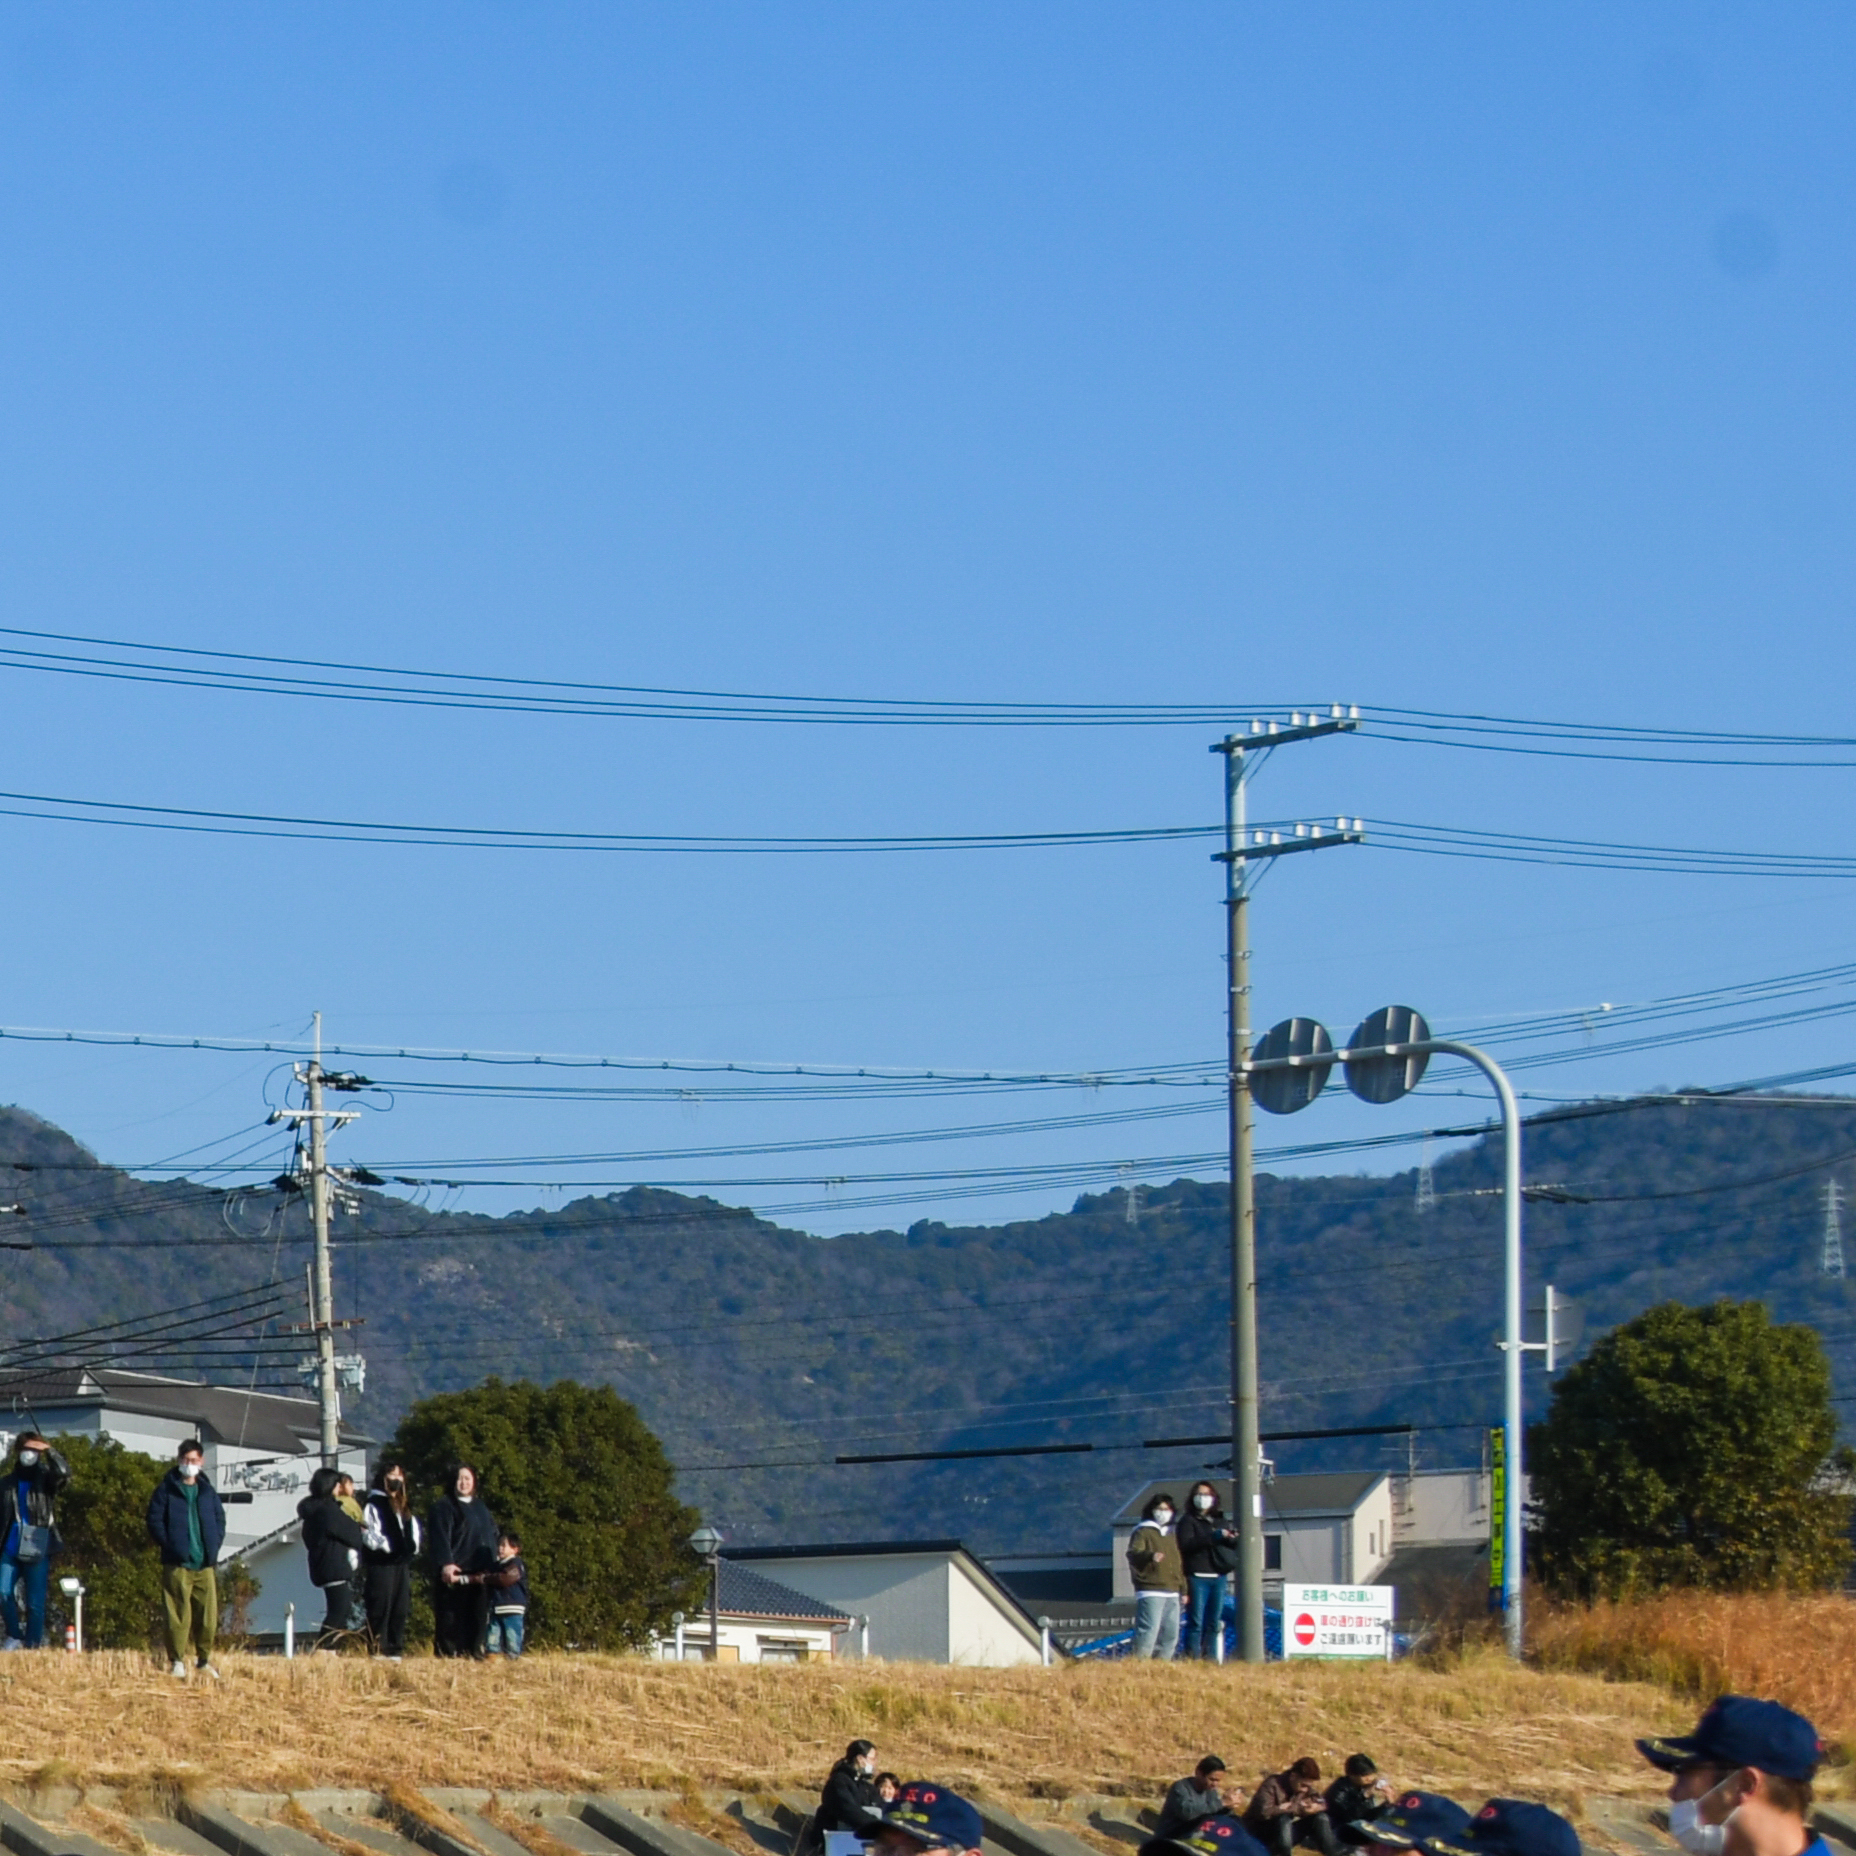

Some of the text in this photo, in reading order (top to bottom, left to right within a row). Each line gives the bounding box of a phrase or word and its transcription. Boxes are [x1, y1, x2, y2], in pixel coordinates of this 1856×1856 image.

[1302, 1589, 1374, 1602] お客様へのお願い
[1320, 1633, 1382, 1646] ご遠慮願います
